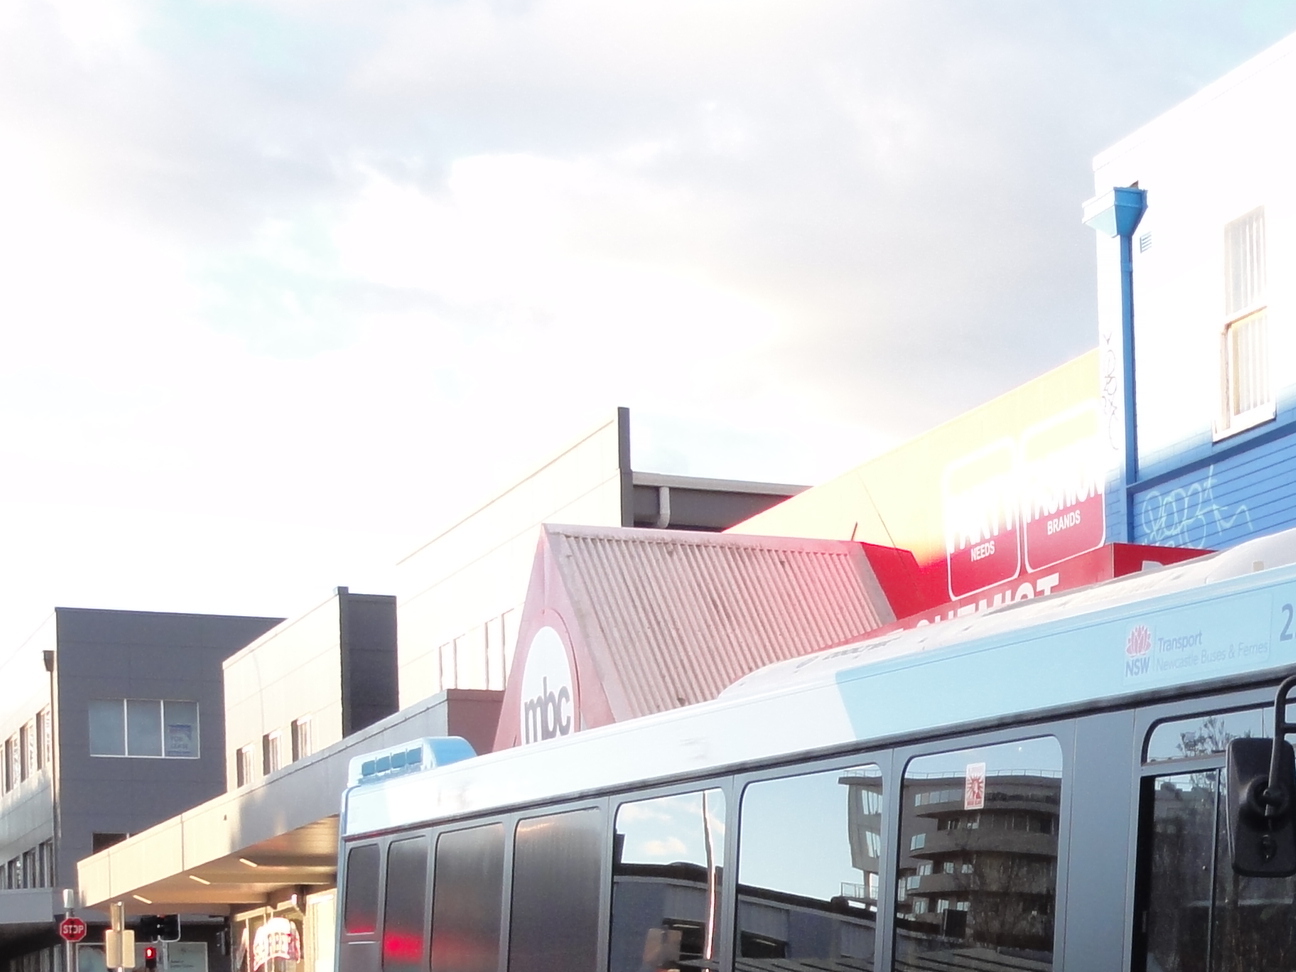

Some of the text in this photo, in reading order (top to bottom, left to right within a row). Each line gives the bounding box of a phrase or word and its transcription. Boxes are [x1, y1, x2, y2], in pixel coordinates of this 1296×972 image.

[1047, 509, 1081, 536] BRANDS
[970, 541, 995, 563] NEEDS
[1157, 631, 1203, 654] Transport
[1125, 657, 1151, 679] NSW
[1156, 641, 1269, 672] Newcastle Buses & Ferries
[524, 676, 572, 745] mbc
[62, 924, 84, 934] STOP
